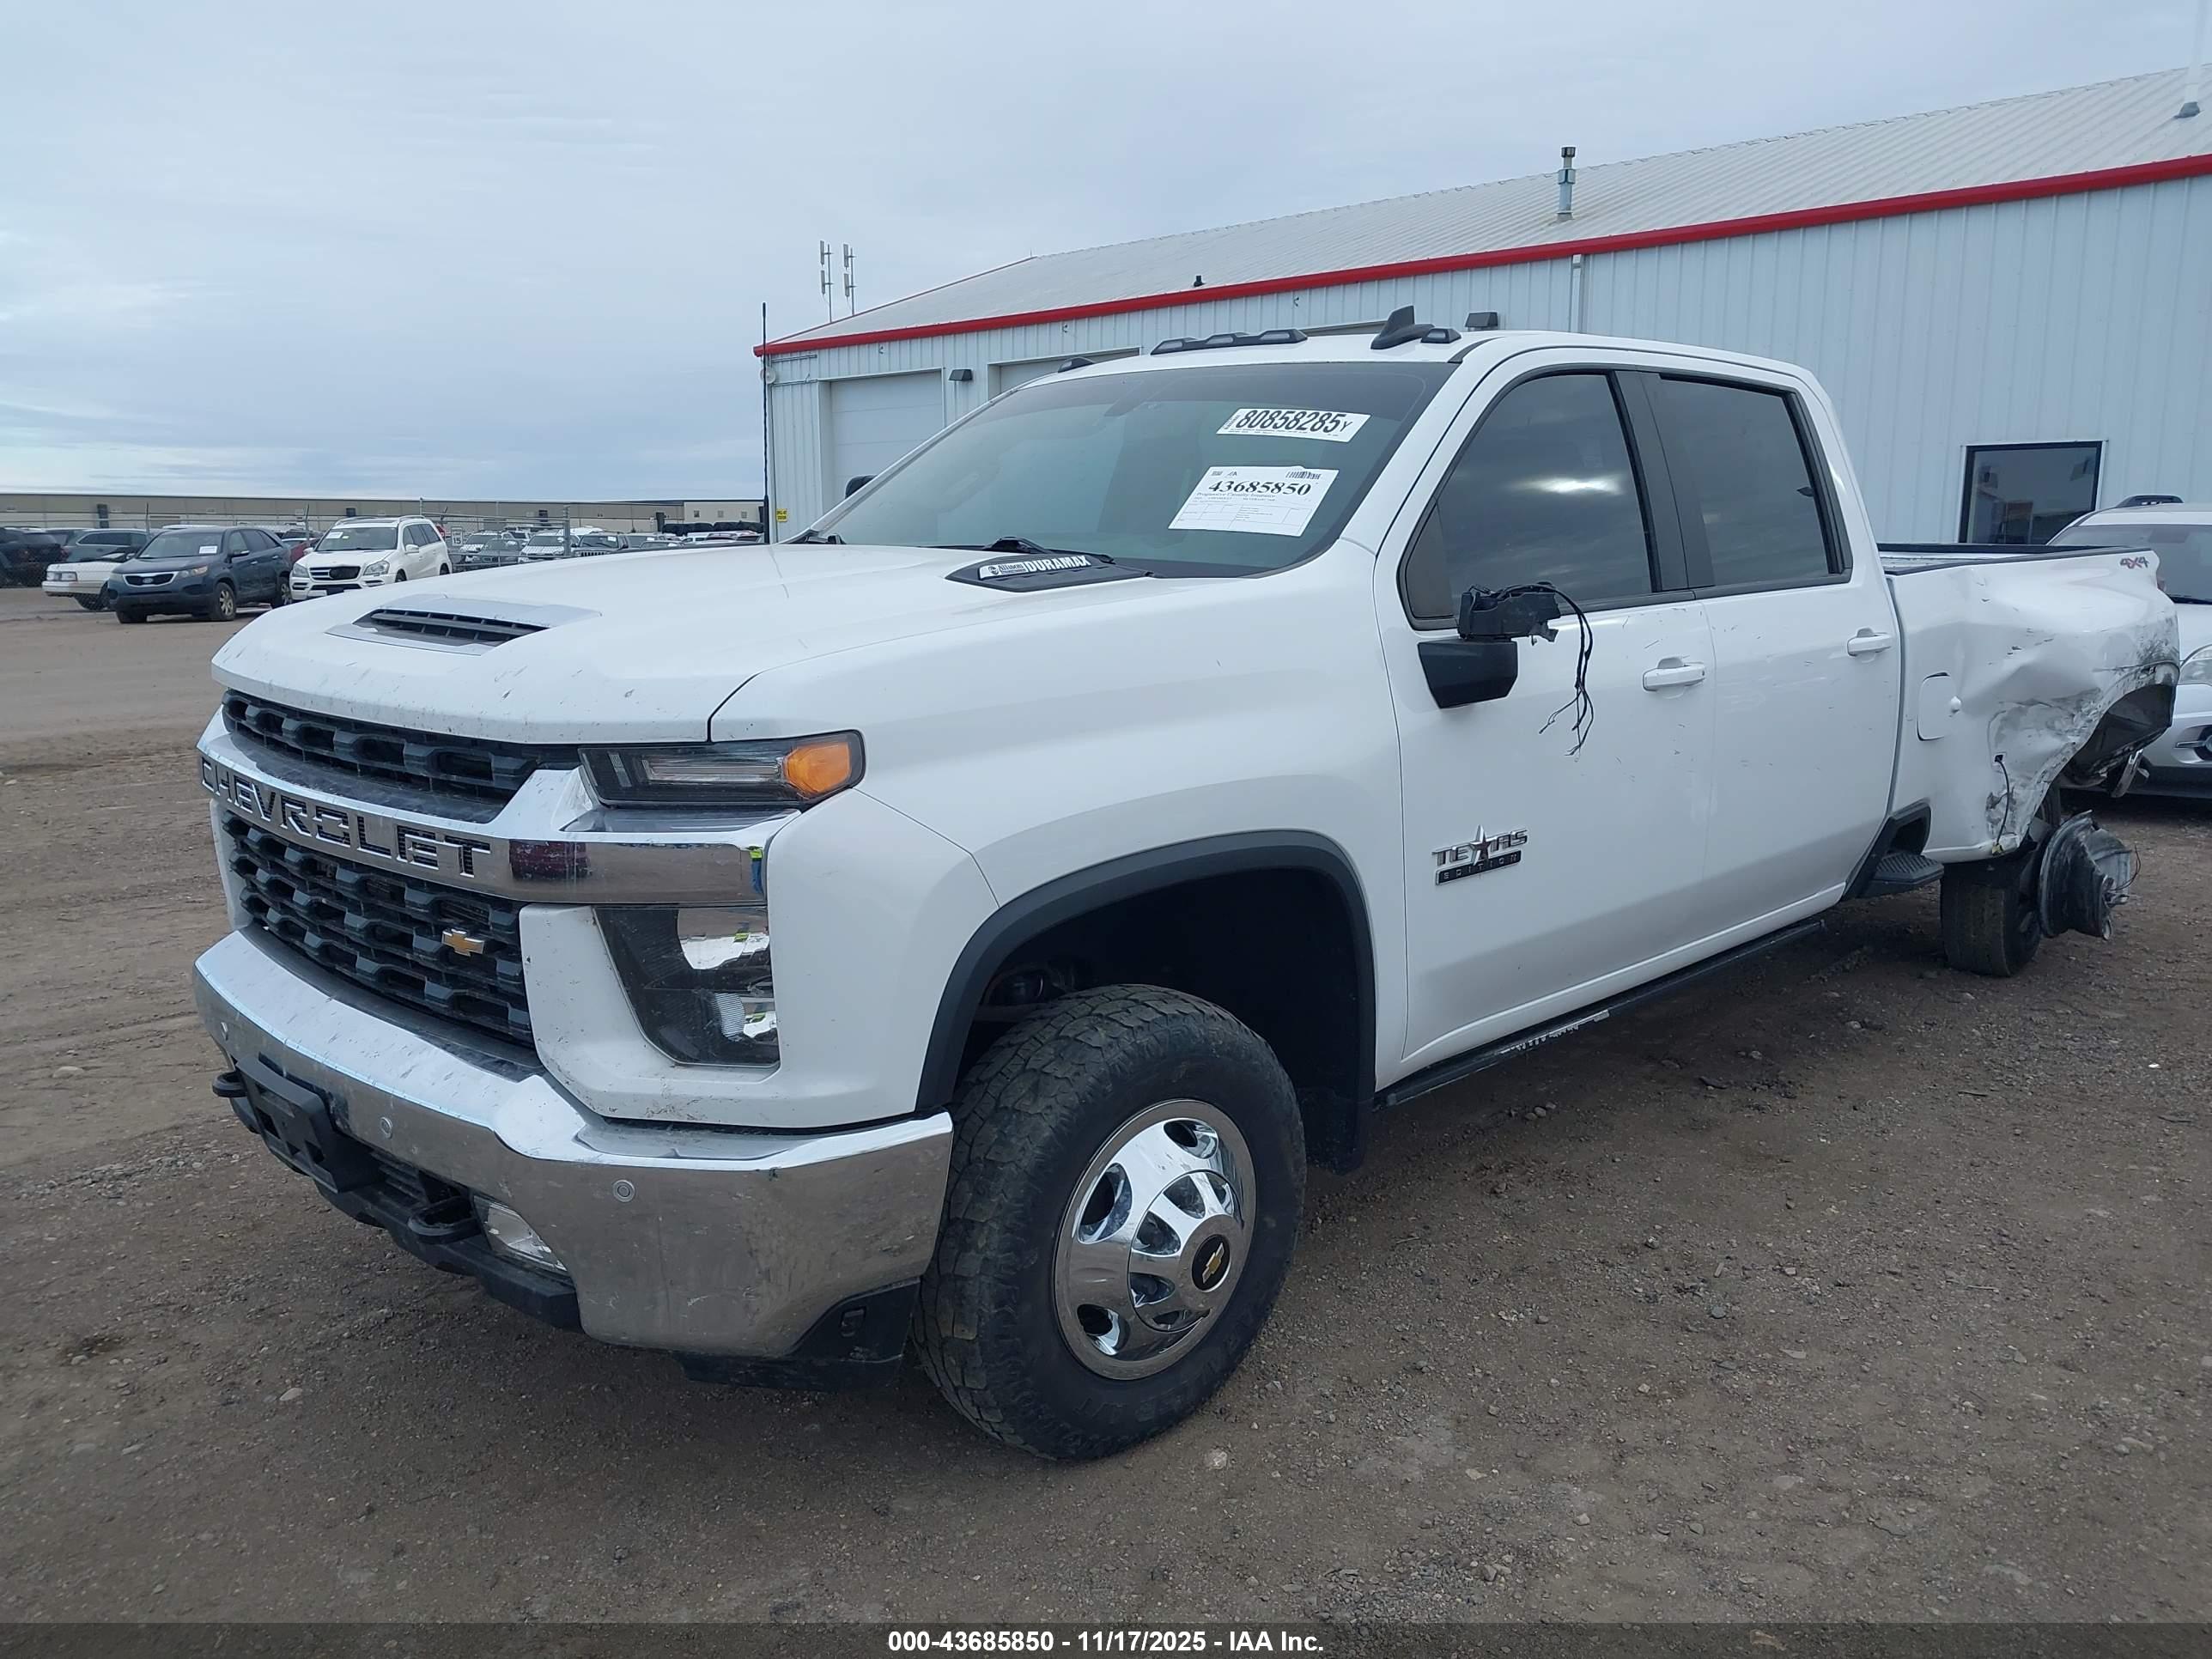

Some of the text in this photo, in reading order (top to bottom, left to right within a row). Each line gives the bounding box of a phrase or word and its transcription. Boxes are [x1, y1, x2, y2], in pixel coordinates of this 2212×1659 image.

[1235, 410, 1346, 433] 80858285
[1208, 480, 1311, 495] 43685850
[1024, 555, 1092, 573] DURAMAX
[201, 757, 491, 878] CHEVROLET
[1443, 854, 1517, 879] EDITION
